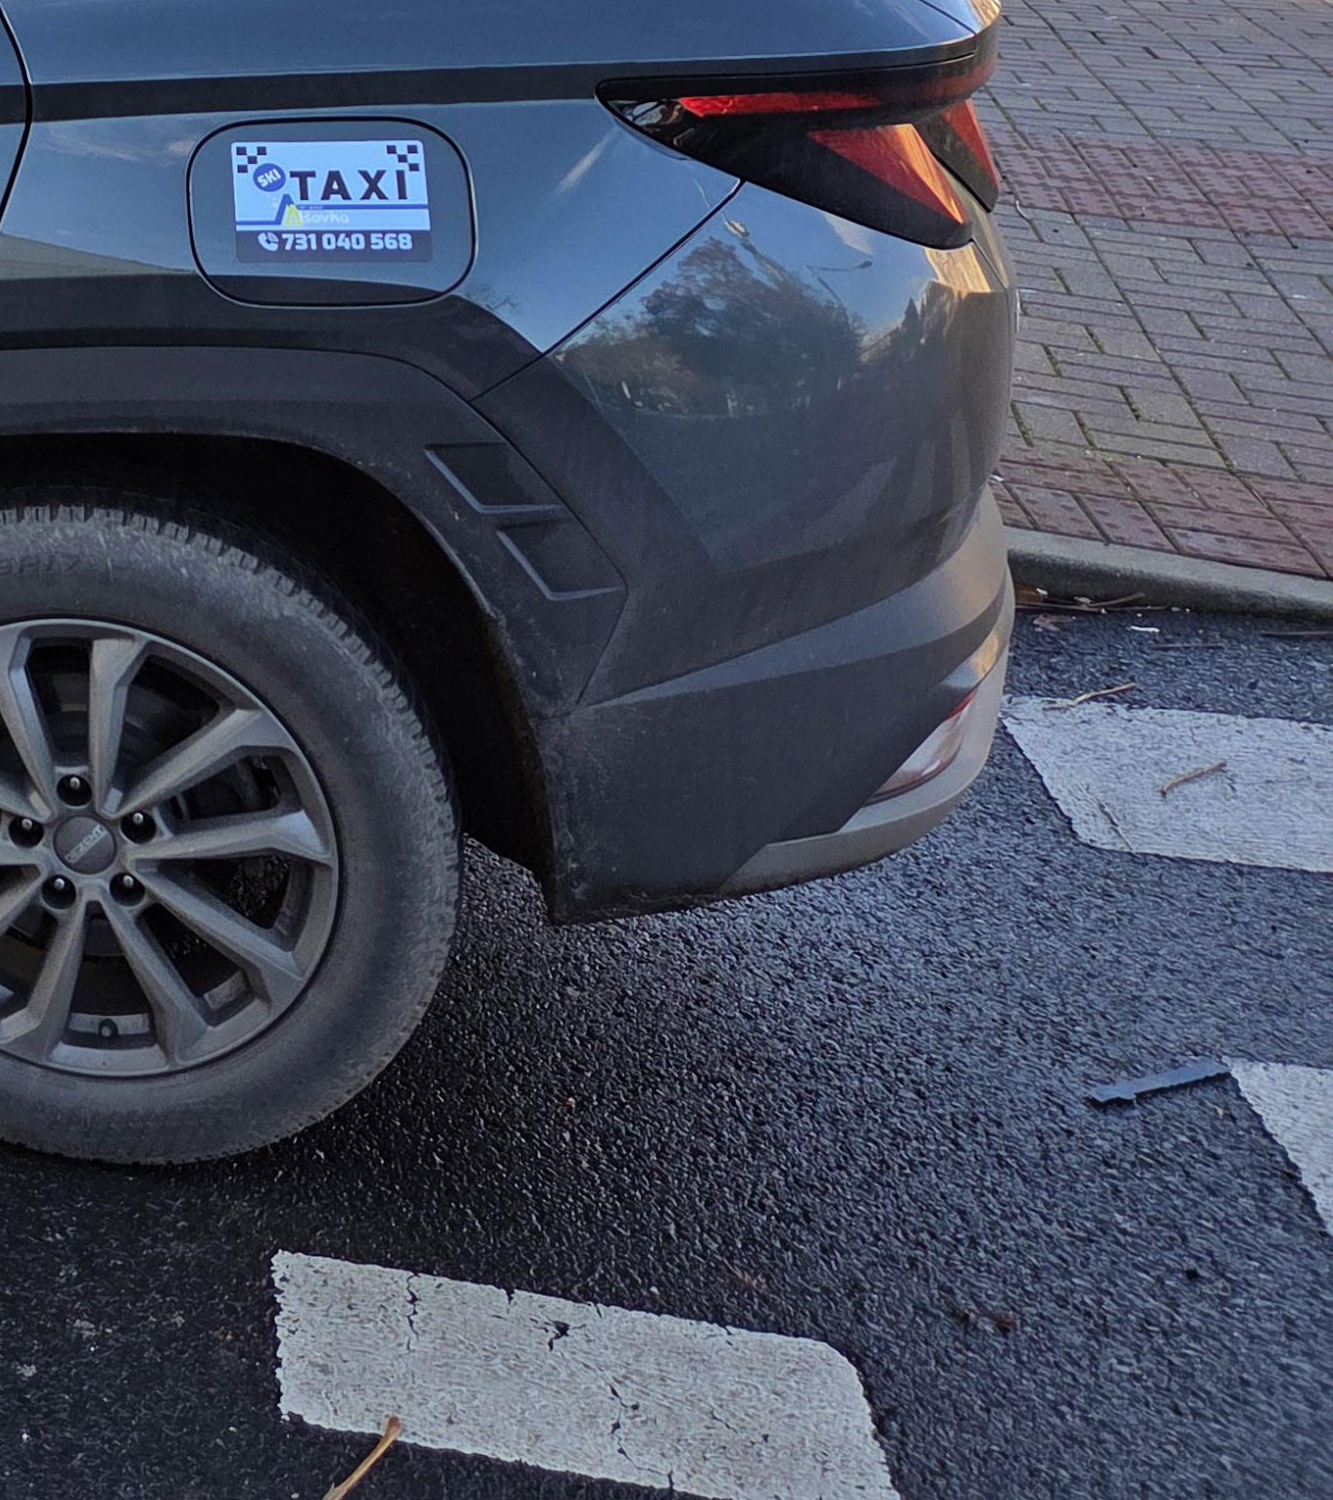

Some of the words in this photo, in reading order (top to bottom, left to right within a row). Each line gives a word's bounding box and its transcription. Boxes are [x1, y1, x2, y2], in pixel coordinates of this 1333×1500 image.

[256, 168, 282, 188] SKI
[289, 169, 409, 201] TAXI
[282, 233, 317, 250] 731
[322, 234, 365, 250] 040
[370, 232, 413, 250] 568
